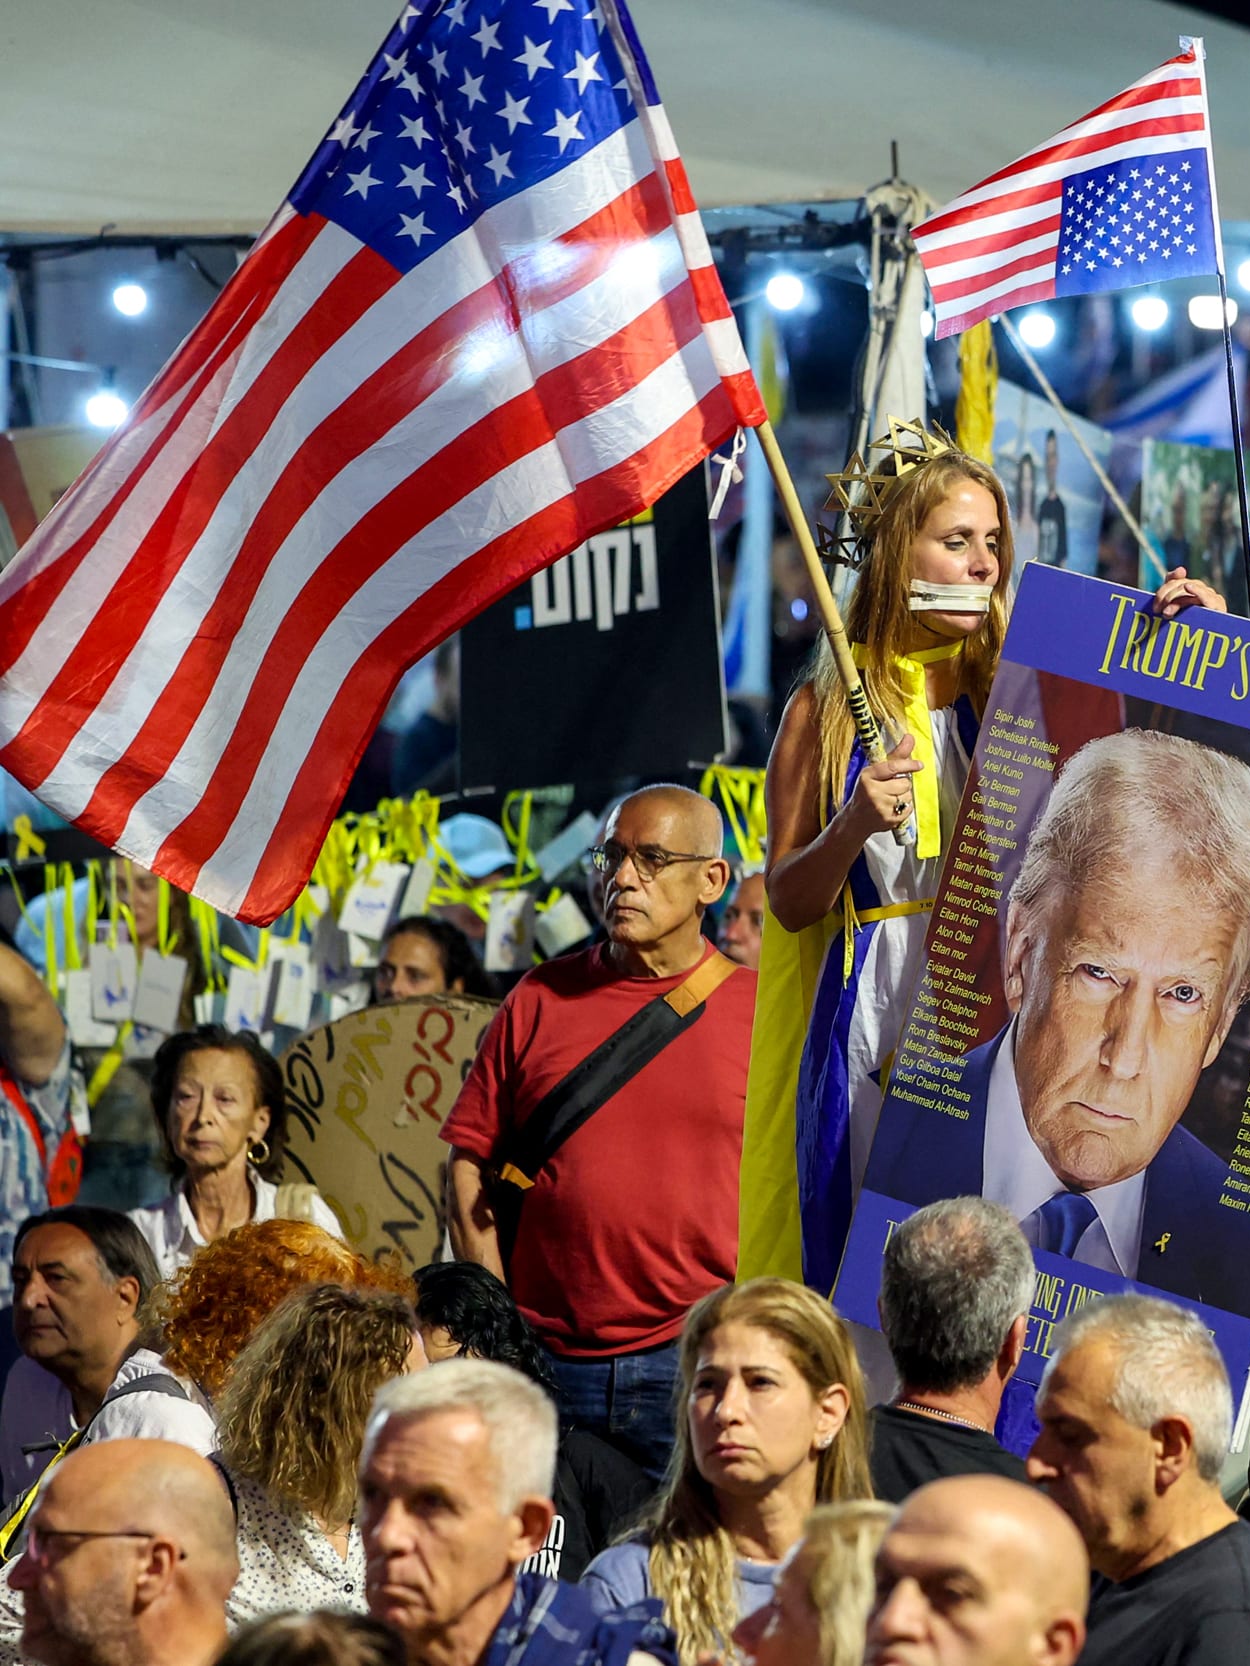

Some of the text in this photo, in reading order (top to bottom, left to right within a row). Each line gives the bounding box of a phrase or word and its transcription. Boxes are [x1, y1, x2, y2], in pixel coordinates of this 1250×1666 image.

[994, 709, 1036, 729] Bipin Joshi
[984, 743, 1011, 759] Joshua
[1032, 756, 1056, 771] Mollel
[983, 760, 1023, 780] Ariel Kunio
[977, 776, 1020, 797] Ziv Berman
[972, 792, 1017, 814] Gali Berman
[967, 809, 1016, 831] Avinathan Or
[962, 825, 1017, 850] Bar Kuperstein
[959, 842, 1000, 862] Omri Miran
[953, 858, 1004, 882] Tamir Nimrodi
[949, 875, 973, 891] Matan
[940, 907, 959, 922] Eitan
[944, 891, 998, 916] Nimrod Cohen
[936, 925, 974, 944] Alon Ohel
[931, 941, 967, 960] Eitan mor
[926, 960, 976, 984] Eviatar David
[918, 991, 941, 1008] Segev
[922, 975, 992, 1006] Aryeh Zalmanovich
[912, 1007, 979, 1038] Elkana Boochboot
[904, 1039, 927, 1054] Matan
[908, 1023, 968, 1053] Rom Breslavsky
[900, 1053, 962, 1082] Guy Gilboa Dalal
[895, 1068, 971, 1103] Yosef Chaim Ochana
[891, 1086, 935, 1109] Muhammad
[1219, 1193, 1246, 1211] Maxim
